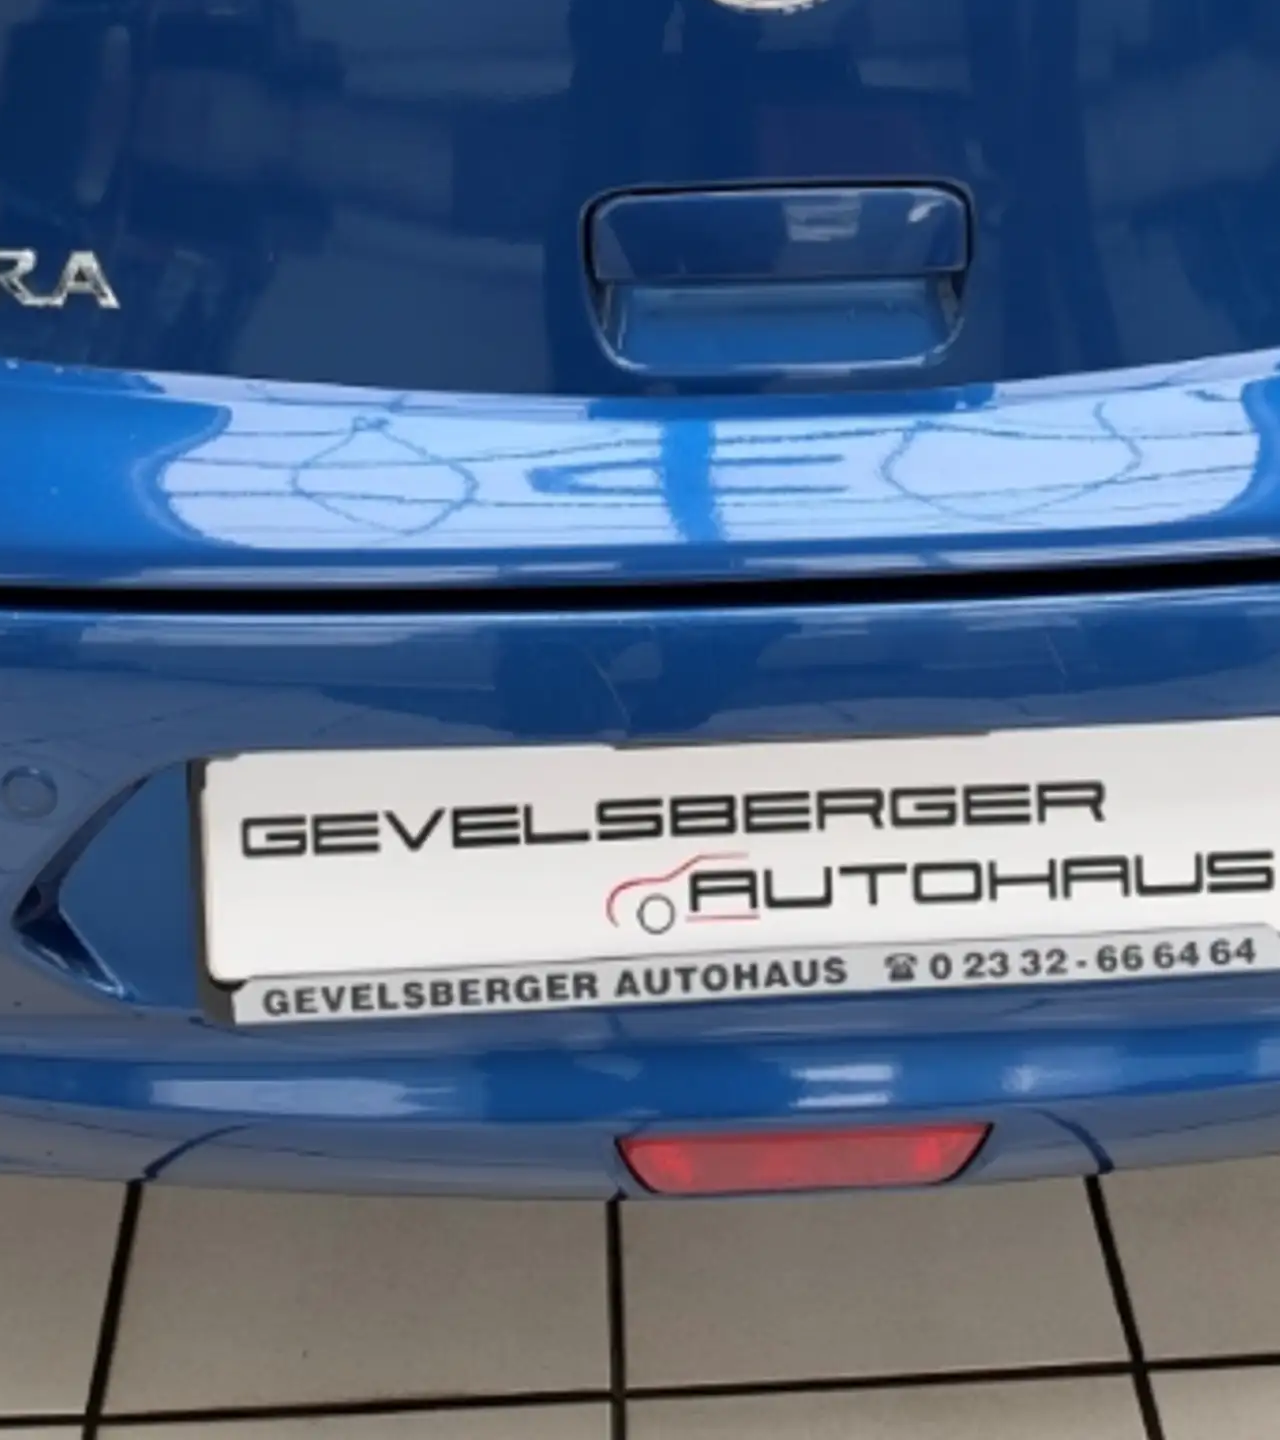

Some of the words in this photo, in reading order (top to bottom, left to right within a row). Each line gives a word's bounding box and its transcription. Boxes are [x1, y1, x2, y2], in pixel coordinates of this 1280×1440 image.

[241, 780, 1106, 858] GEVELSBERGER
[688, 850, 1275, 913] AUTOHAUS
[263, 971, 599, 1016] GEVELSBERGER
[613, 956, 849, 996] AUTOHAUS
